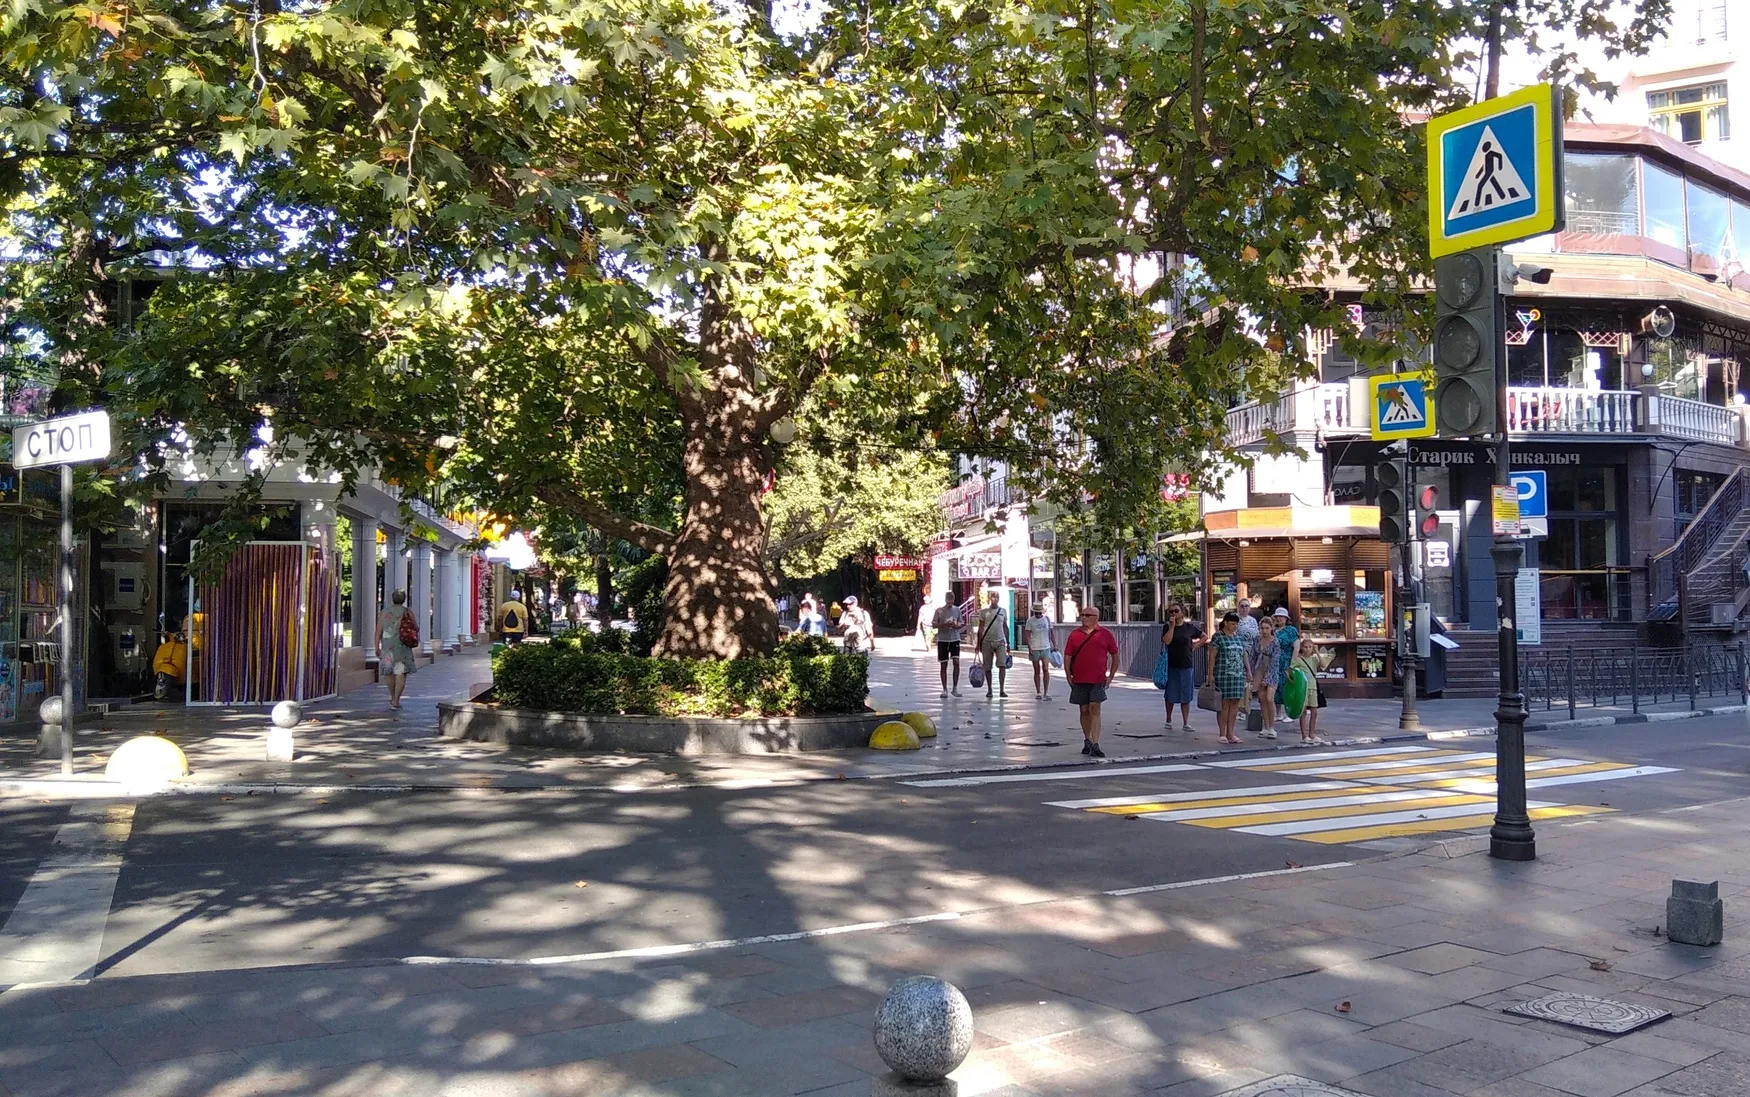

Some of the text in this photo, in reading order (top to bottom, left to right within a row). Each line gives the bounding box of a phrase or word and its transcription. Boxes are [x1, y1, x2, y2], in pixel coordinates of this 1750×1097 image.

[27, 424, 92, 458] СТОП
[1408, 446, 1581, 468] Старик Хнкалыч
[971, 566, 990, 577] BAR
